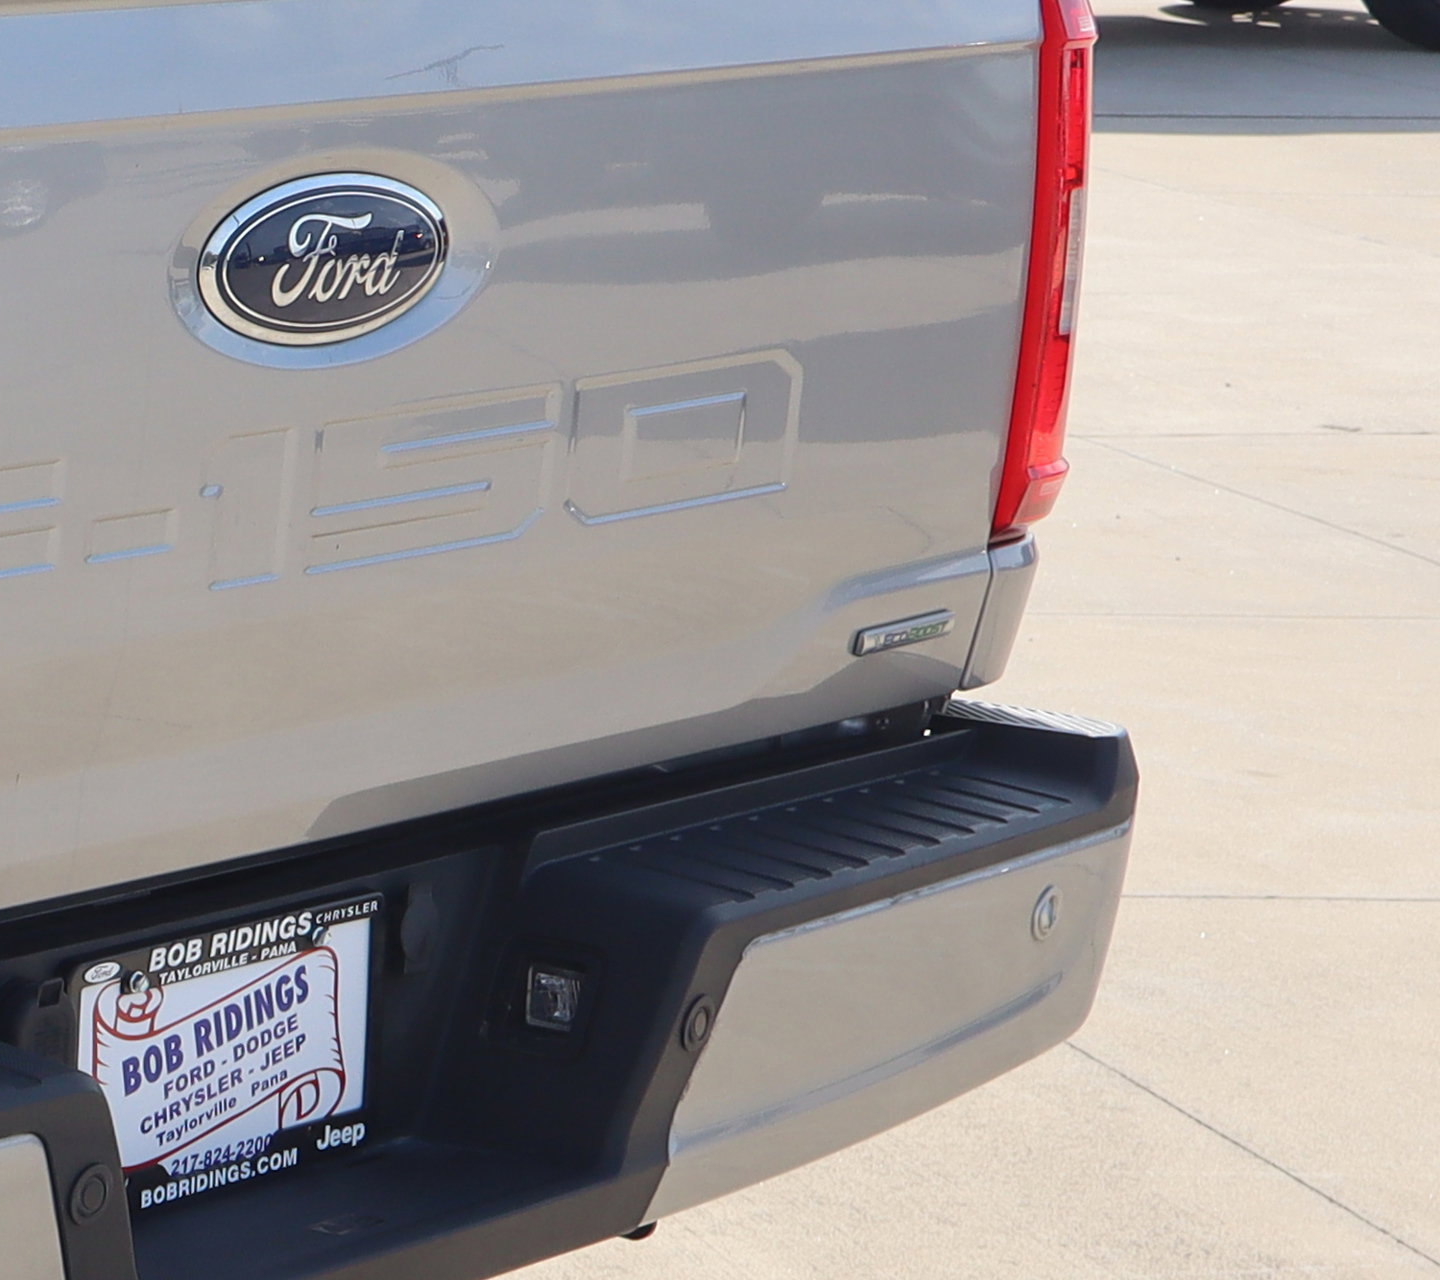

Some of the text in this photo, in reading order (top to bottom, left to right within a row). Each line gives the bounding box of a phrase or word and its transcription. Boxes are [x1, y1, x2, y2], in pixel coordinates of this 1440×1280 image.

[272, 212, 406, 308] Ford
[149, 911, 313, 972] BOB RIDINGS
[315, 900, 379, 924] CHRYSLER
[159, 958, 248, 985] TAYLORVILLE
[260, 941, 297, 961] PANA
[121, 965, 310, 1096] BOB RIDINGS
[163, 1059, 216, 1099] FORD
[233, 1014, 299, 1063] DODGE
[139, 1072, 243, 1135] CHRYSLER
[260, 1034, 308, 1071] JEEP
[155, 1069, 289, 1147] Taylorville Pana
[170, 1132, 273, 1177] 217-824-2200
[316, 1123, 366, 1151] Jeep
[140, 1148, 298, 1209] BOBRIDINGS.COM
